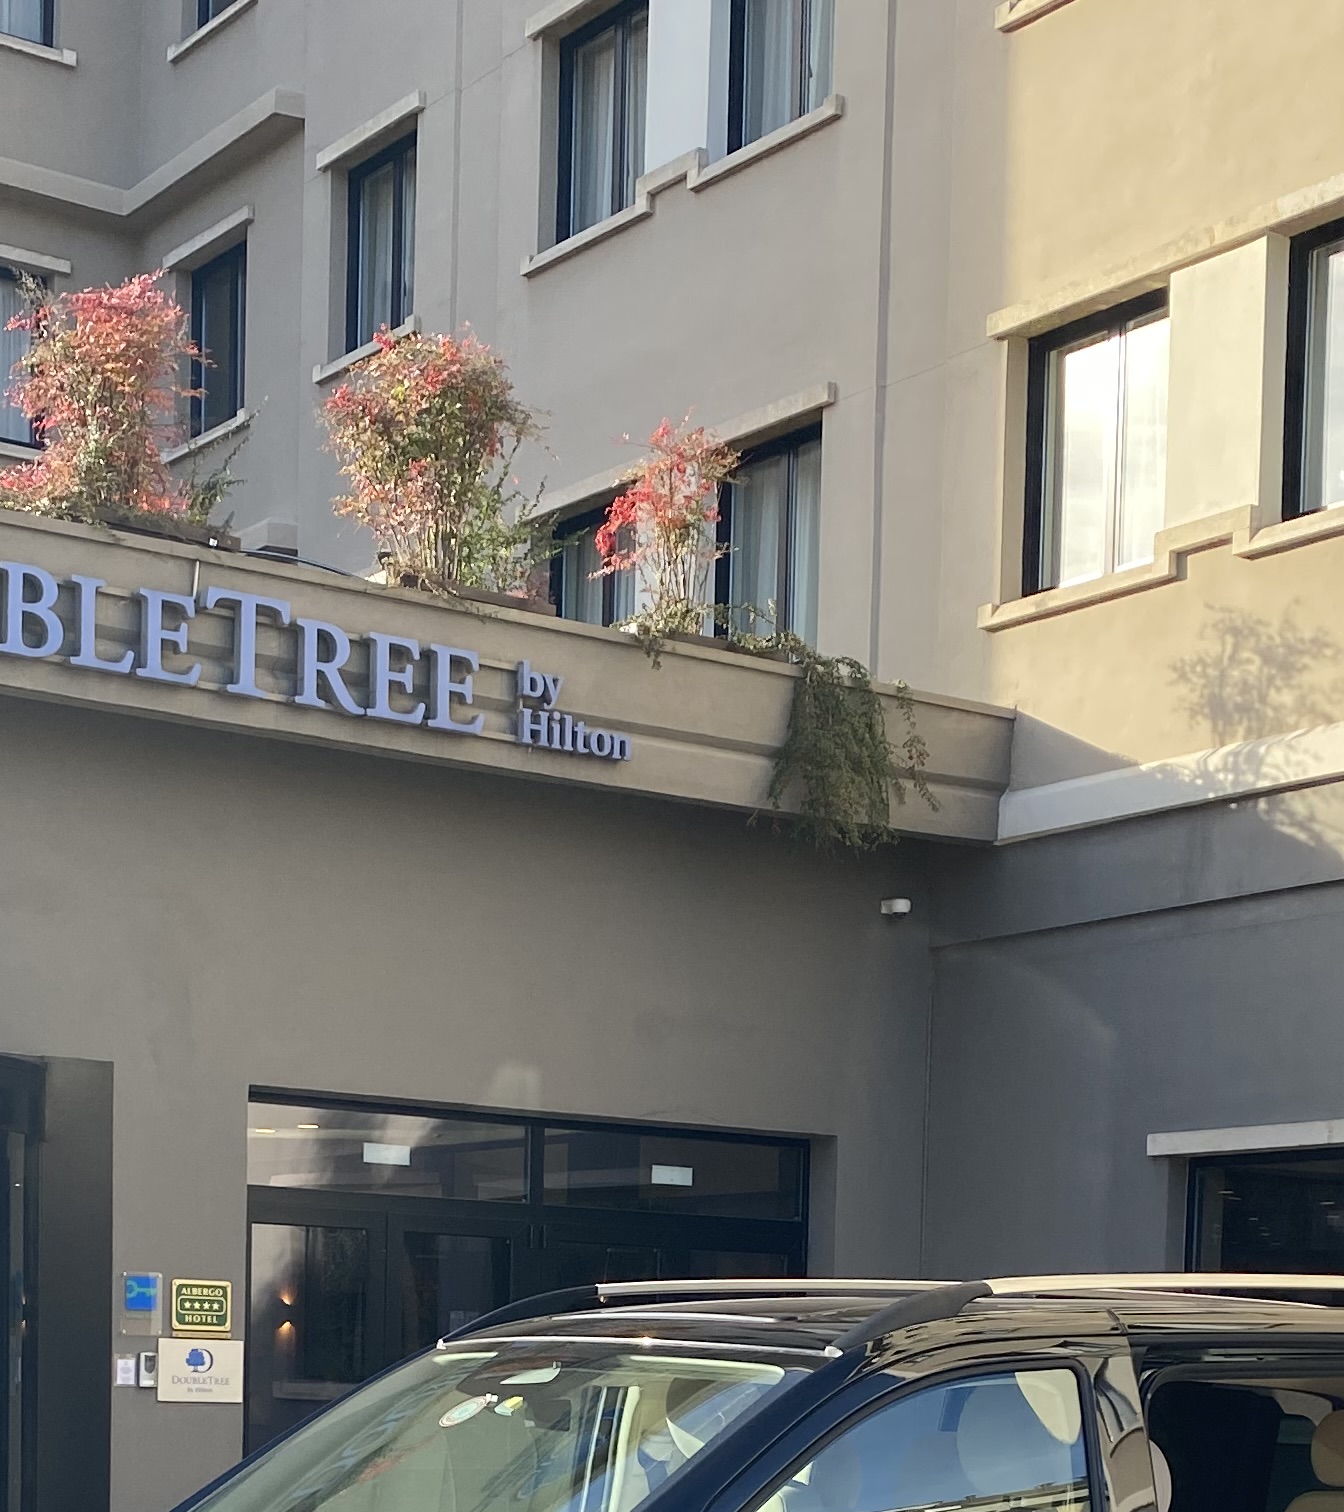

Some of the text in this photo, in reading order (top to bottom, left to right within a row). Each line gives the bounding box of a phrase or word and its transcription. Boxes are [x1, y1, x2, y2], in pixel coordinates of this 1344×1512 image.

[517, 660, 563, 711] by
[517, 708, 632, 761] Hilton
[181, 1287, 223, 1297] ALBERGO
[184, 1314, 218, 1324] HOTEL
